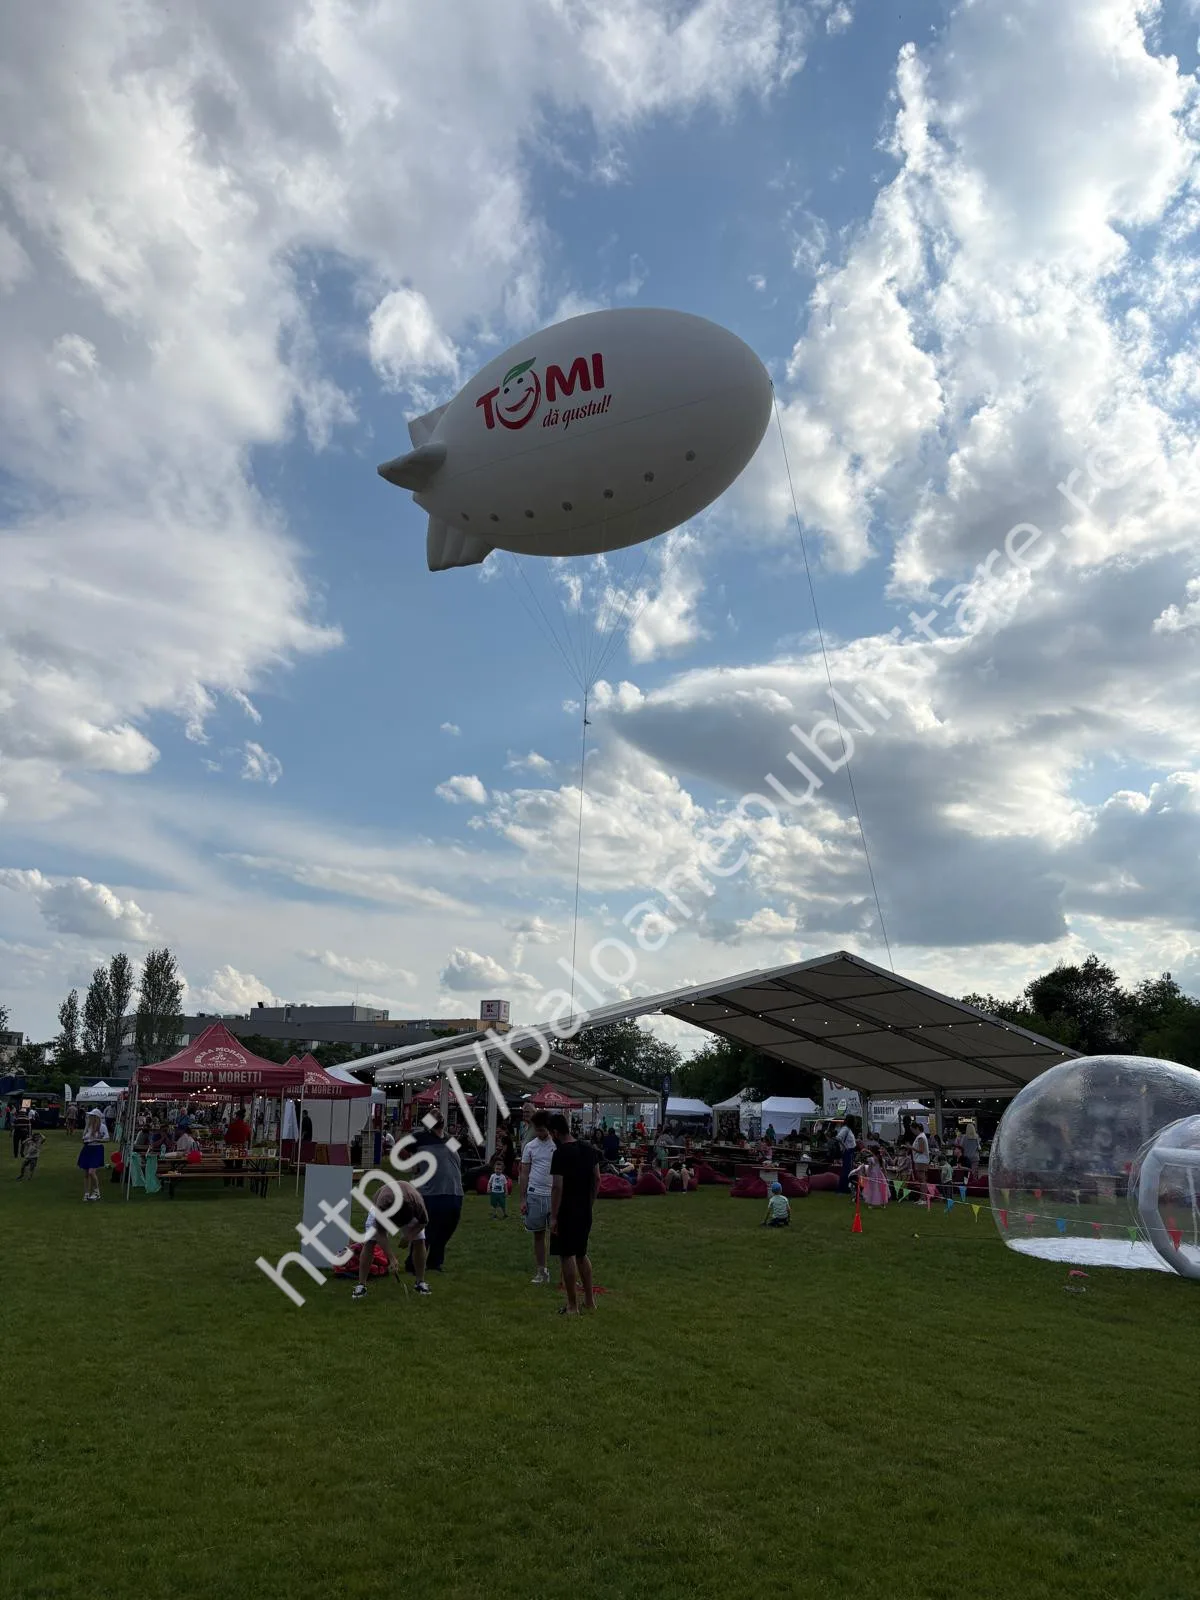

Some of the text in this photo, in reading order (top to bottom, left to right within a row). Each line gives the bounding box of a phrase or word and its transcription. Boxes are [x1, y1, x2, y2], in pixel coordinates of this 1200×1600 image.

[476, 353, 605, 430] TOMI
[542, 394, 612, 431] dă gustul!
[182, 1070, 262, 1083] BIRRA MORETTI
[311, 1085, 343, 1095] MORETTI
